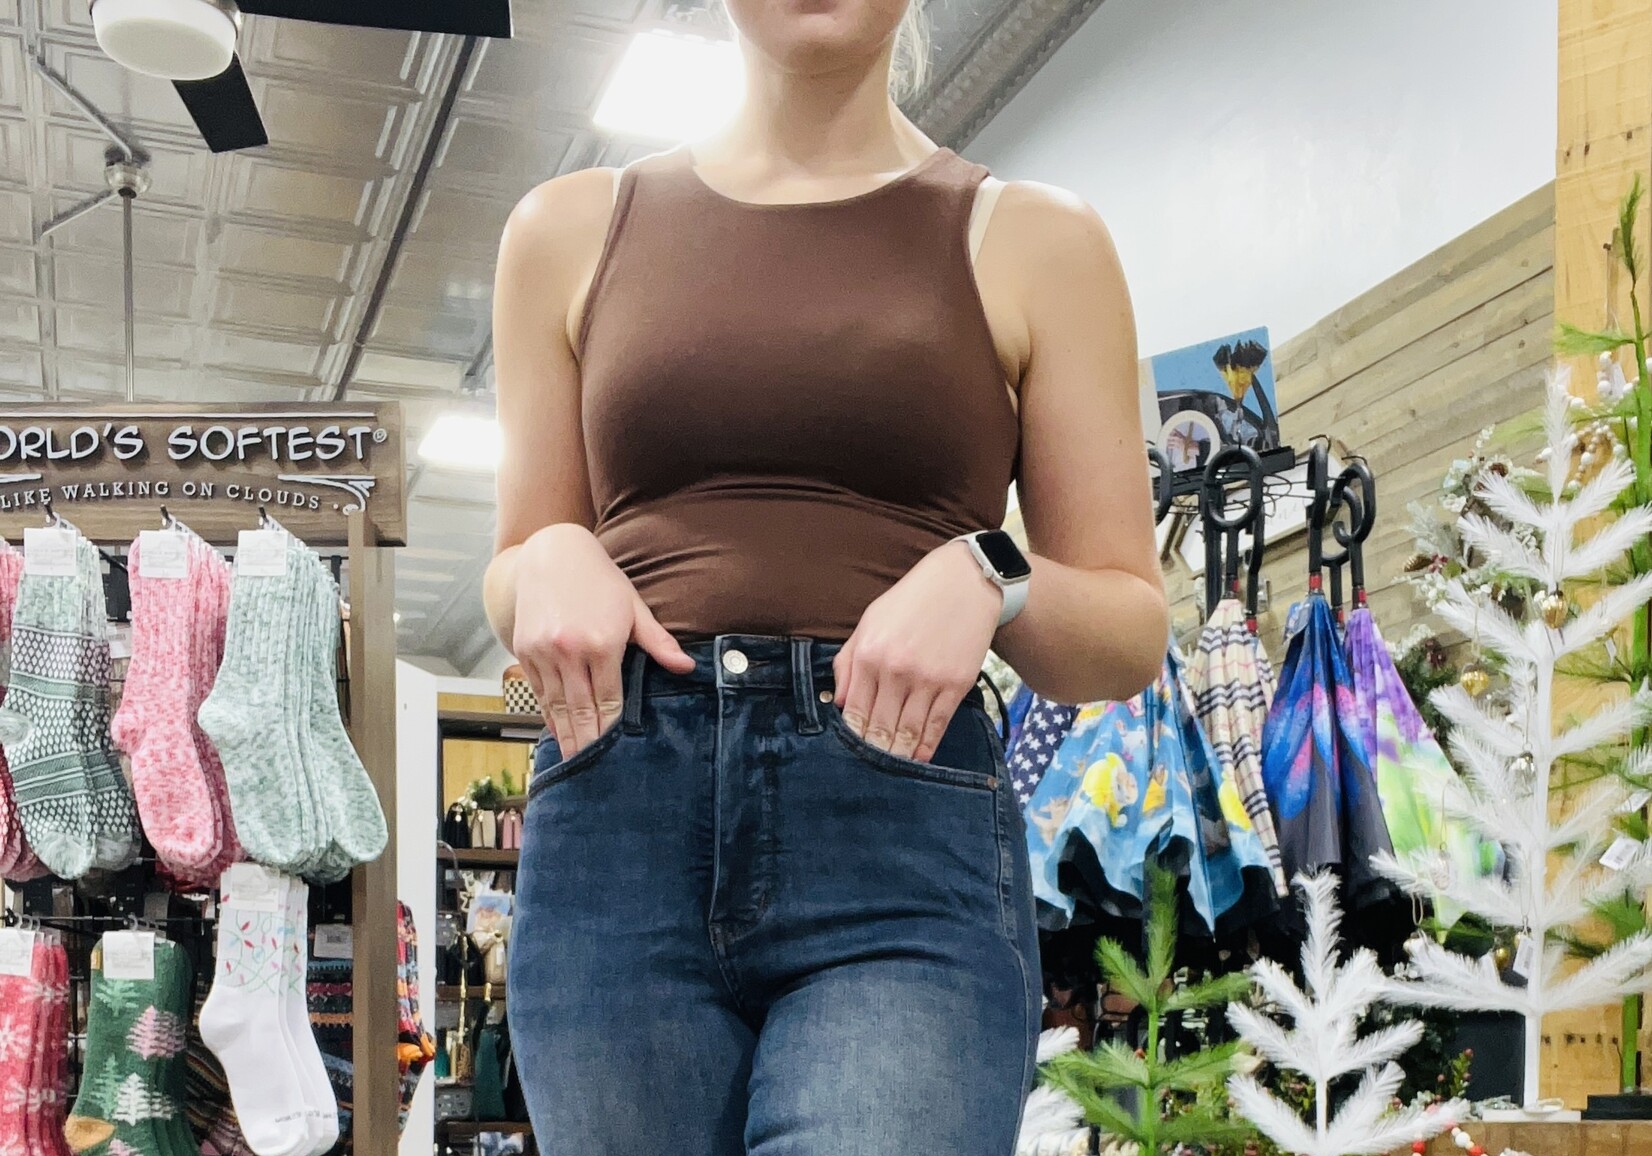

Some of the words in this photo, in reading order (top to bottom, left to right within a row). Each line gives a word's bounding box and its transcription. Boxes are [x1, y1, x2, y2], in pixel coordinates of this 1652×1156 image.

[0, 423, 144, 460] ORLD'S
[1, 488, 51, 509] LIKE
[61, 481, 169, 500] WALKING
[182, 481, 214, 497] ON
[226, 484, 320, 509] CLOUDS
